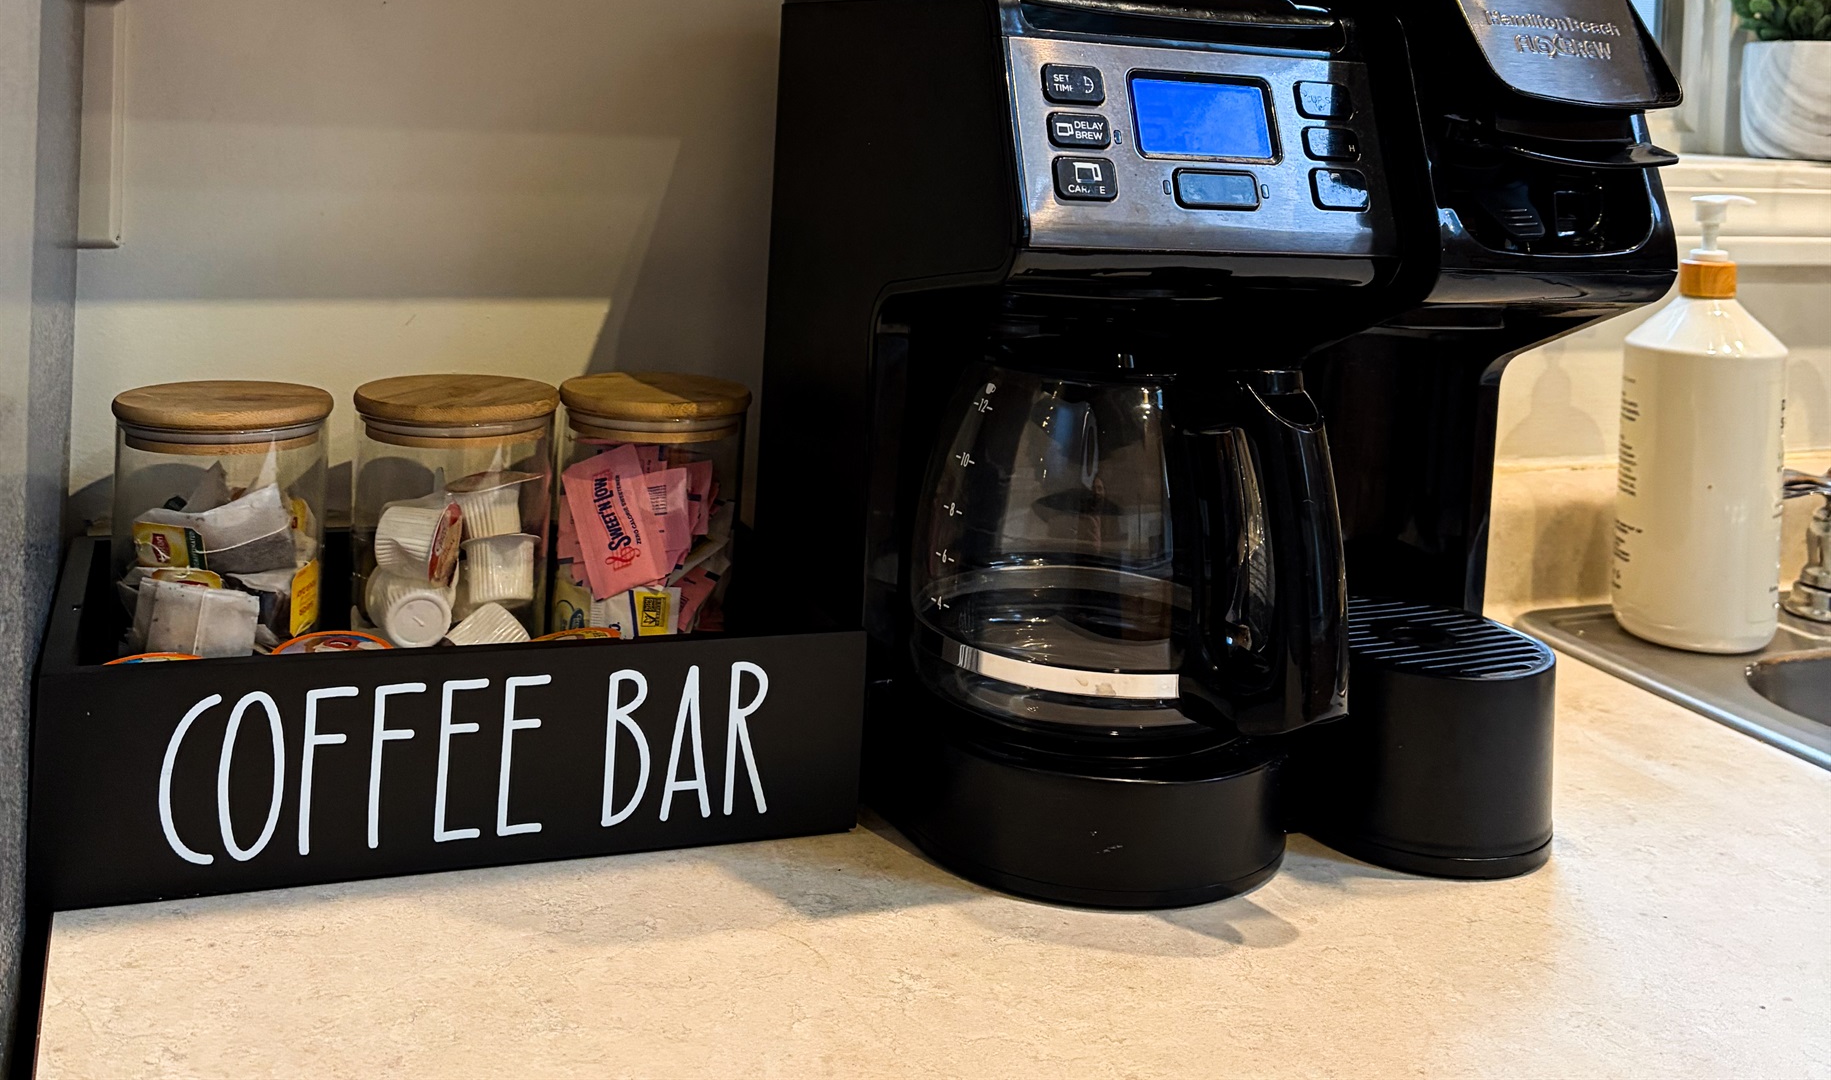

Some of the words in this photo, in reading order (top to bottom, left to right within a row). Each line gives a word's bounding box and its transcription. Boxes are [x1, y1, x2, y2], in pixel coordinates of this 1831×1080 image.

[1053, 74, 1069, 83] SET
[1074, 120, 1103, 131] DELAY
[1075, 130, 1103, 140] BREW
[1068, 184, 1106, 195] CARE
[159, 675, 552, 865] COFFEE
[602, 661, 769, 827] BAR
